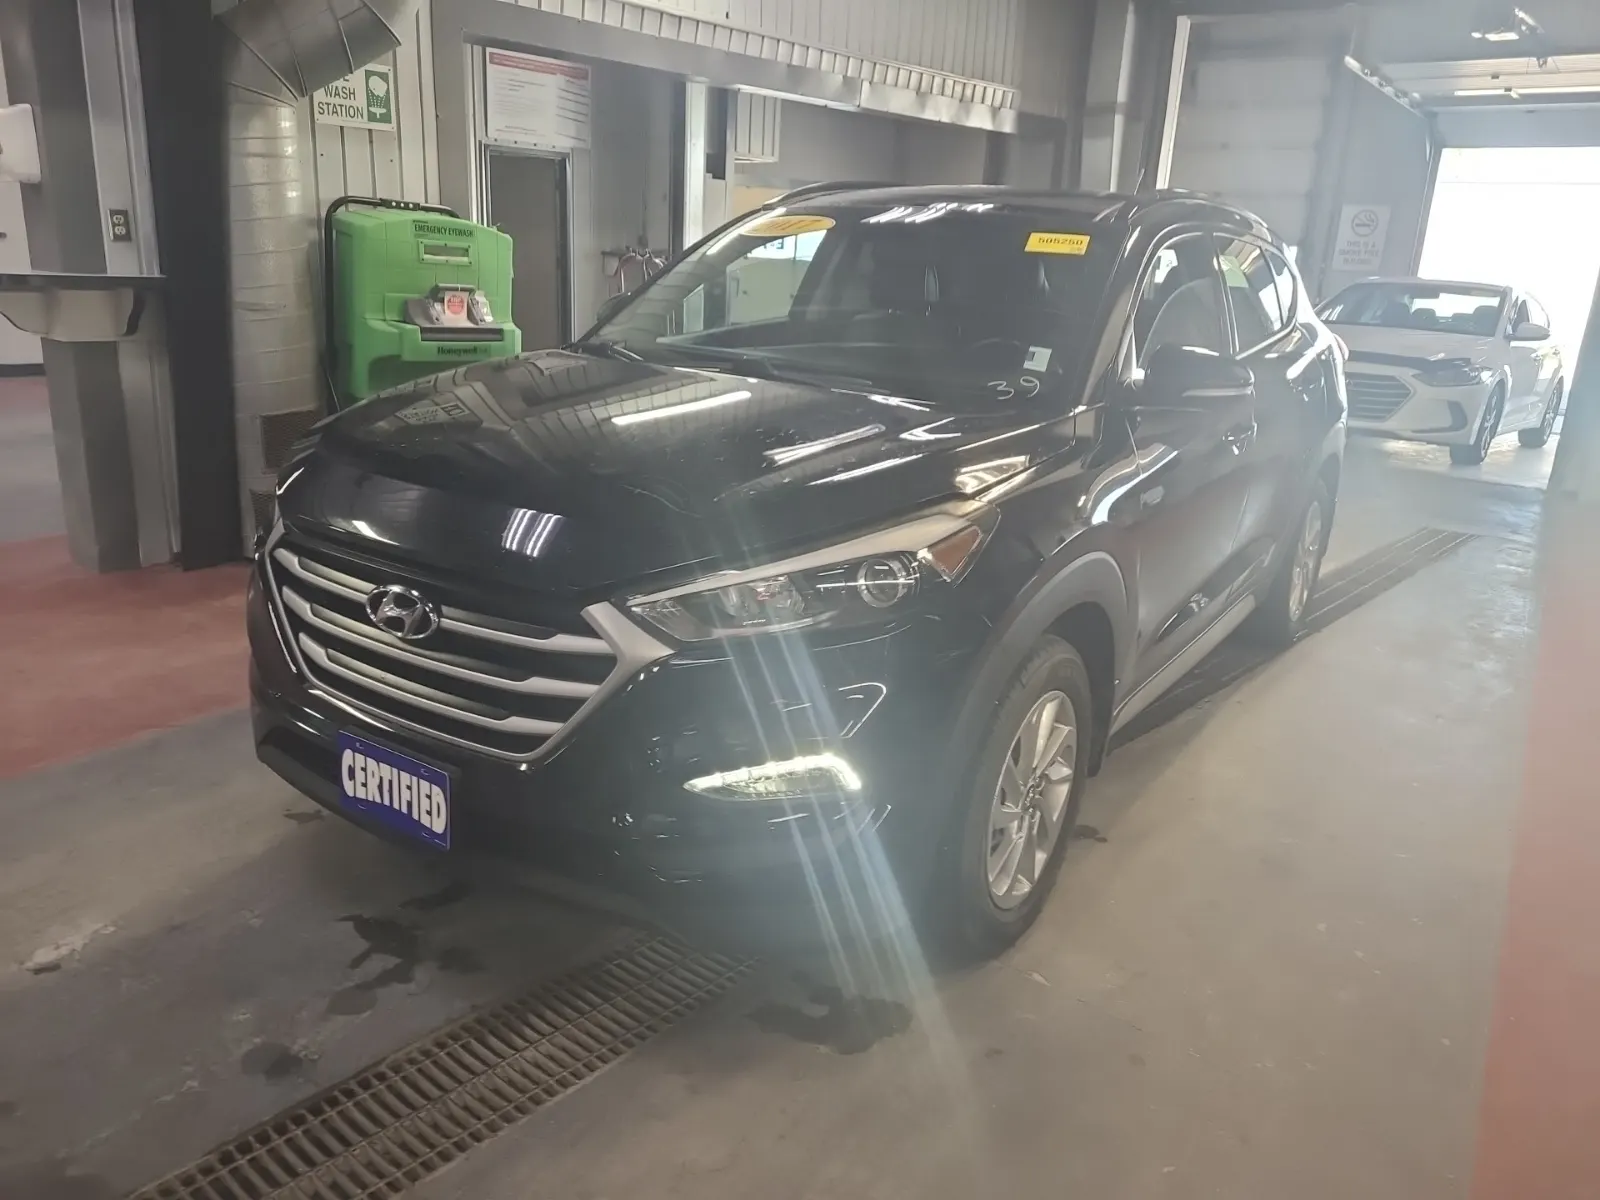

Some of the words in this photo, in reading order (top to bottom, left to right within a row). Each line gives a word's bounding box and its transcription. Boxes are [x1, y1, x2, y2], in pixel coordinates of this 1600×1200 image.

[323, 84, 356, 101] WASH
[317, 101, 364, 120] STATION
[414, 223, 448, 236] EMERGENCY
[448, 227, 475, 238] EYEWASH
[437, 345, 478, 356] Honeywell
[341, 748, 447, 835] CERTIFIED
